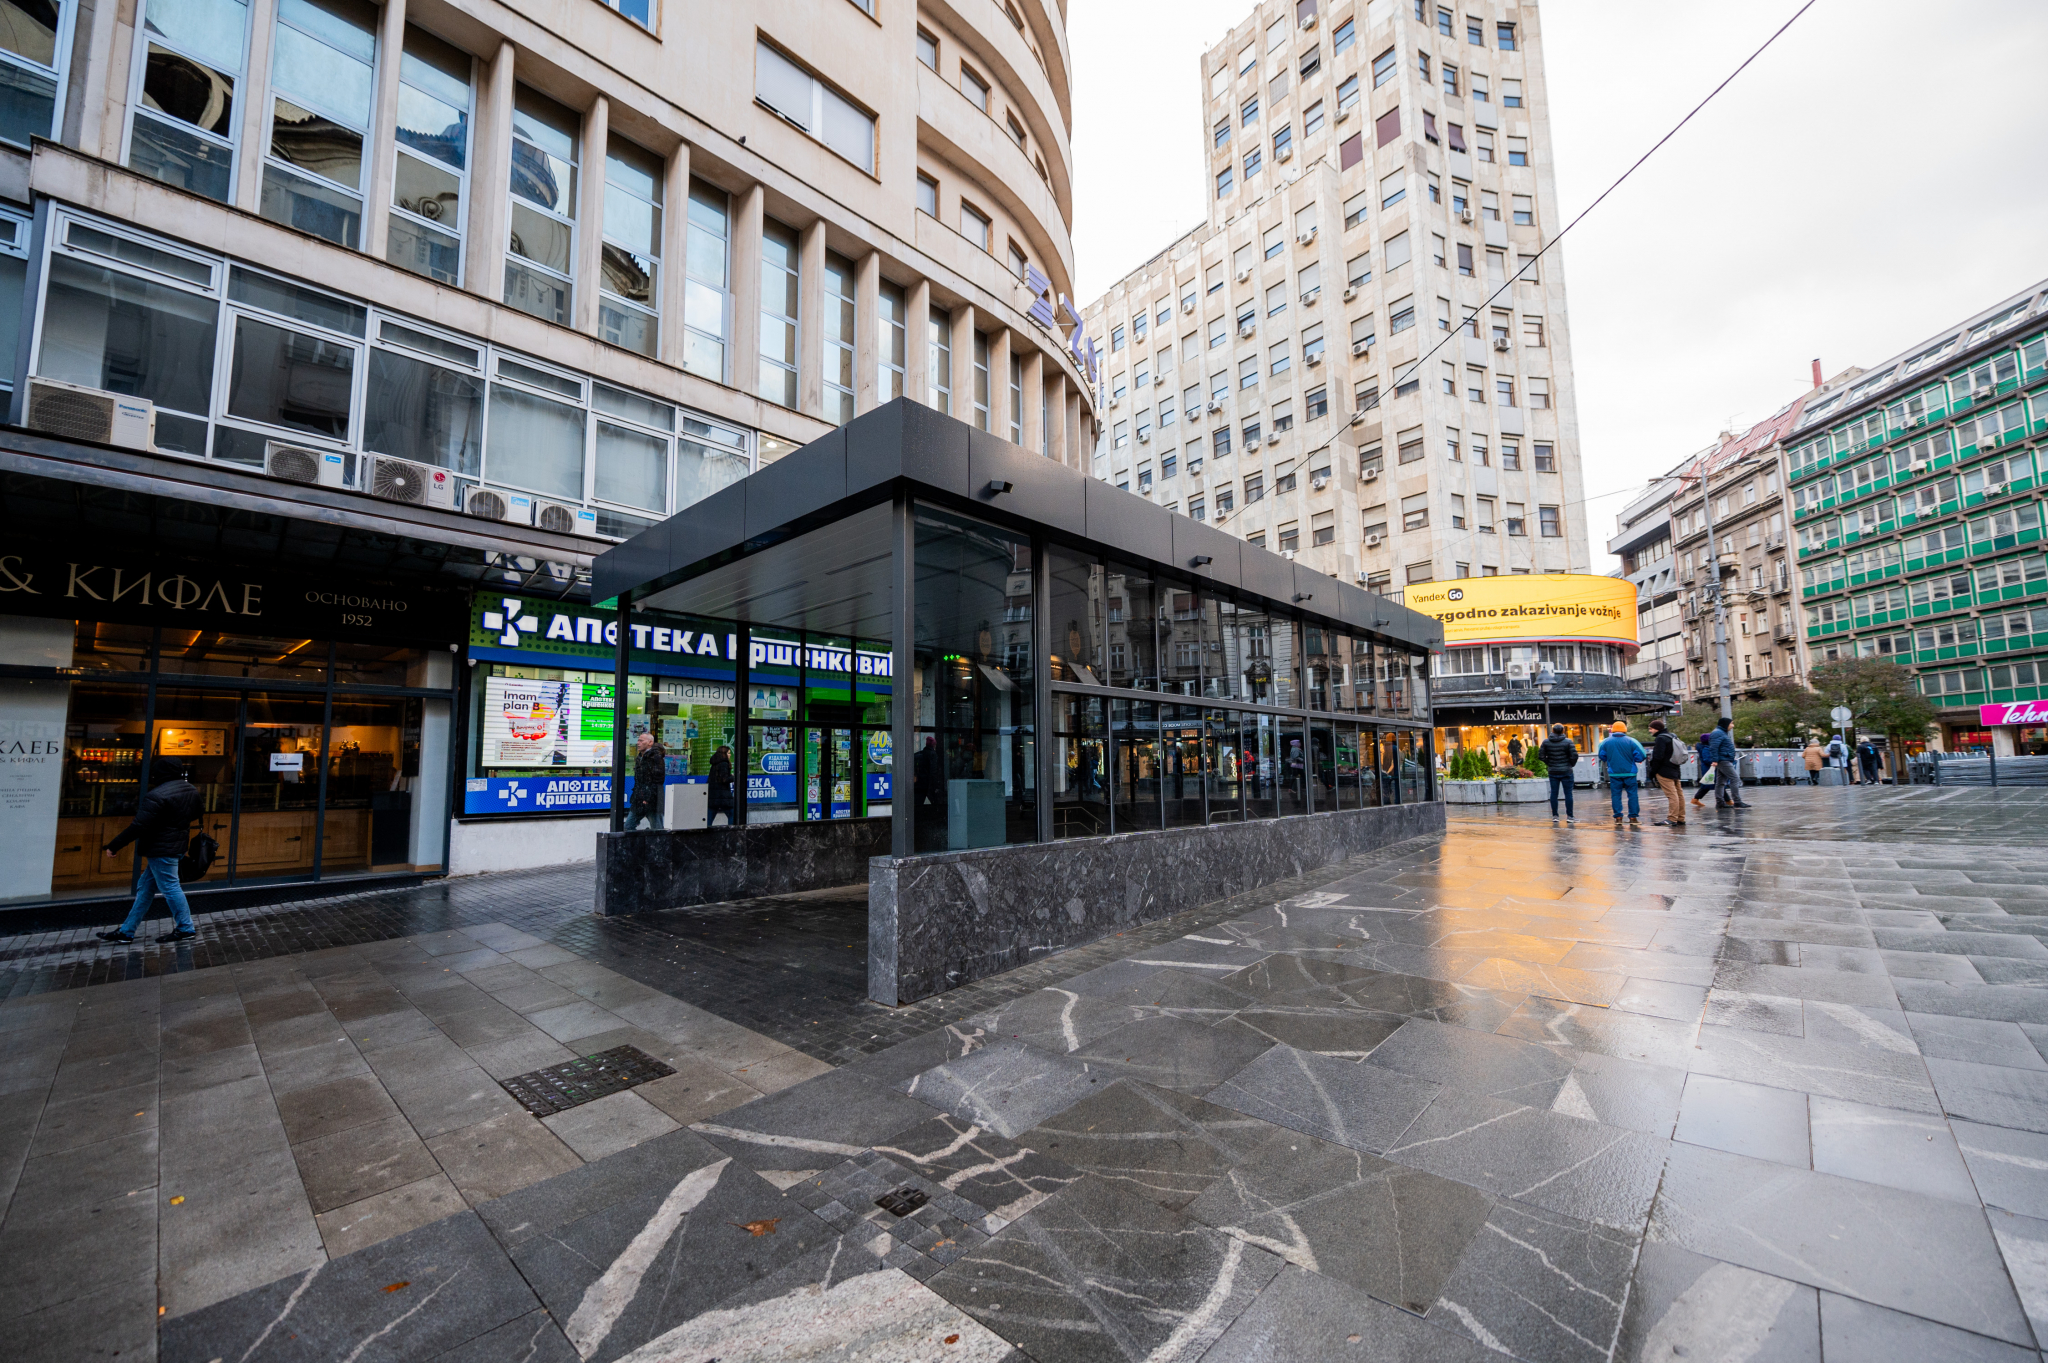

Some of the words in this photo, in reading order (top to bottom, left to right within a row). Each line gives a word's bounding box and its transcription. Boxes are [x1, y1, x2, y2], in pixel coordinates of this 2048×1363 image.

[118, 404, 147, 413] Panasonic
[0, 555, 42, 594] &
[63, 562, 262, 616] КИФЛЕ
[305, 591, 408, 612] ОСНОВАНО
[1413, 593, 1446, 603] Yandex
[1448, 590, 1463, 600] Go
[1436, 608, 1497, 622] zgodno
[1500, 604, 1587, 618] zakazivanje
[1589, 605, 1621, 620] vožnje
[341, 613, 373, 627] 1952
[504, 690, 537, 701] Imam
[667, 682, 736, 704] mamajo
[503, 700, 529, 712] plan
[533, 702, 540, 711] B
[1493, 709, 1542, 721] MaxMara
[547, 780, 612, 793] АПОТЕК
